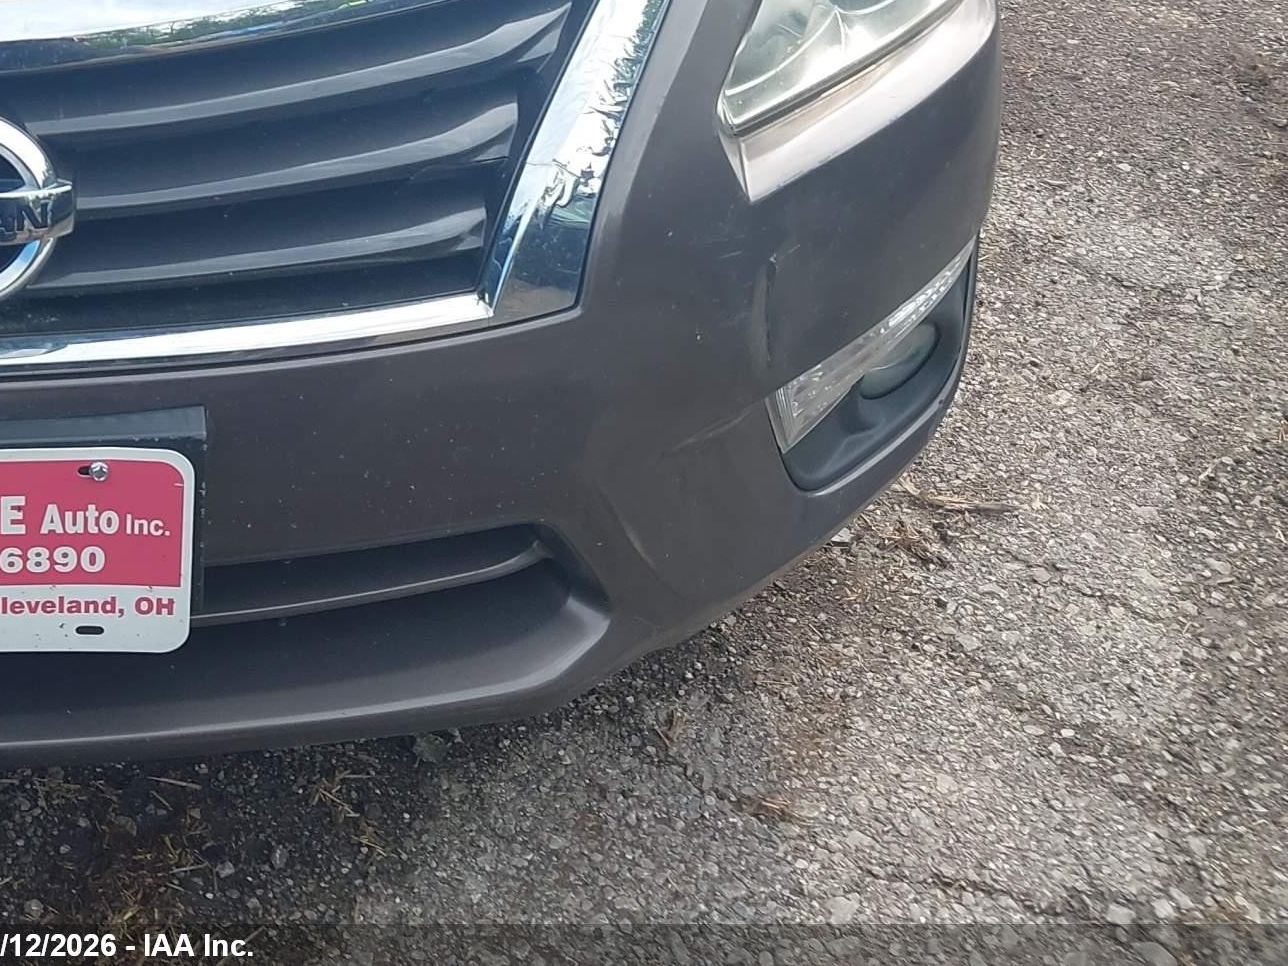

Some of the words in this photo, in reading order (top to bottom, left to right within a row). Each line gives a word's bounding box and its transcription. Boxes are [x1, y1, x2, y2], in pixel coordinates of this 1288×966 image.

[39, 503, 120, 536] Auto
[125, 513, 172, 537] Inc.
[133, 596, 177, 617] OH
